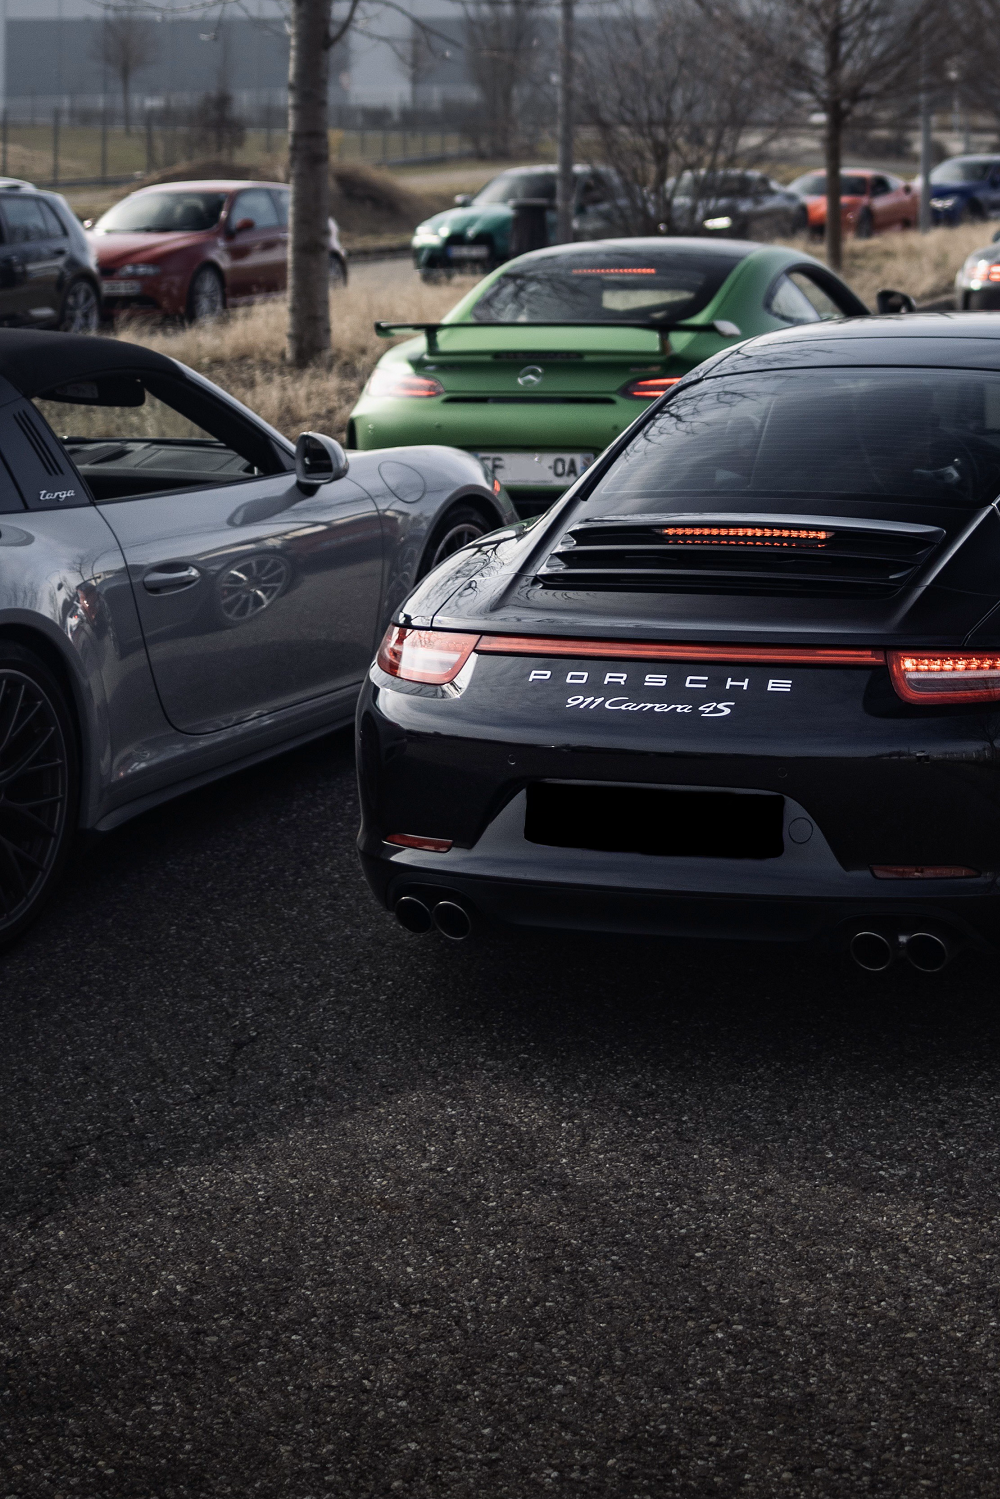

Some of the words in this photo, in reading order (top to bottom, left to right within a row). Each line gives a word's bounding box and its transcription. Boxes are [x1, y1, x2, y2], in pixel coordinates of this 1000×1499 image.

[39, 489, 76, 502] targa
[528, 669, 793, 692] PORSCHE
[565, 695, 605, 709] 911
[604, 696, 692, 714] Carrera
[698, 702, 736, 717] 4S
